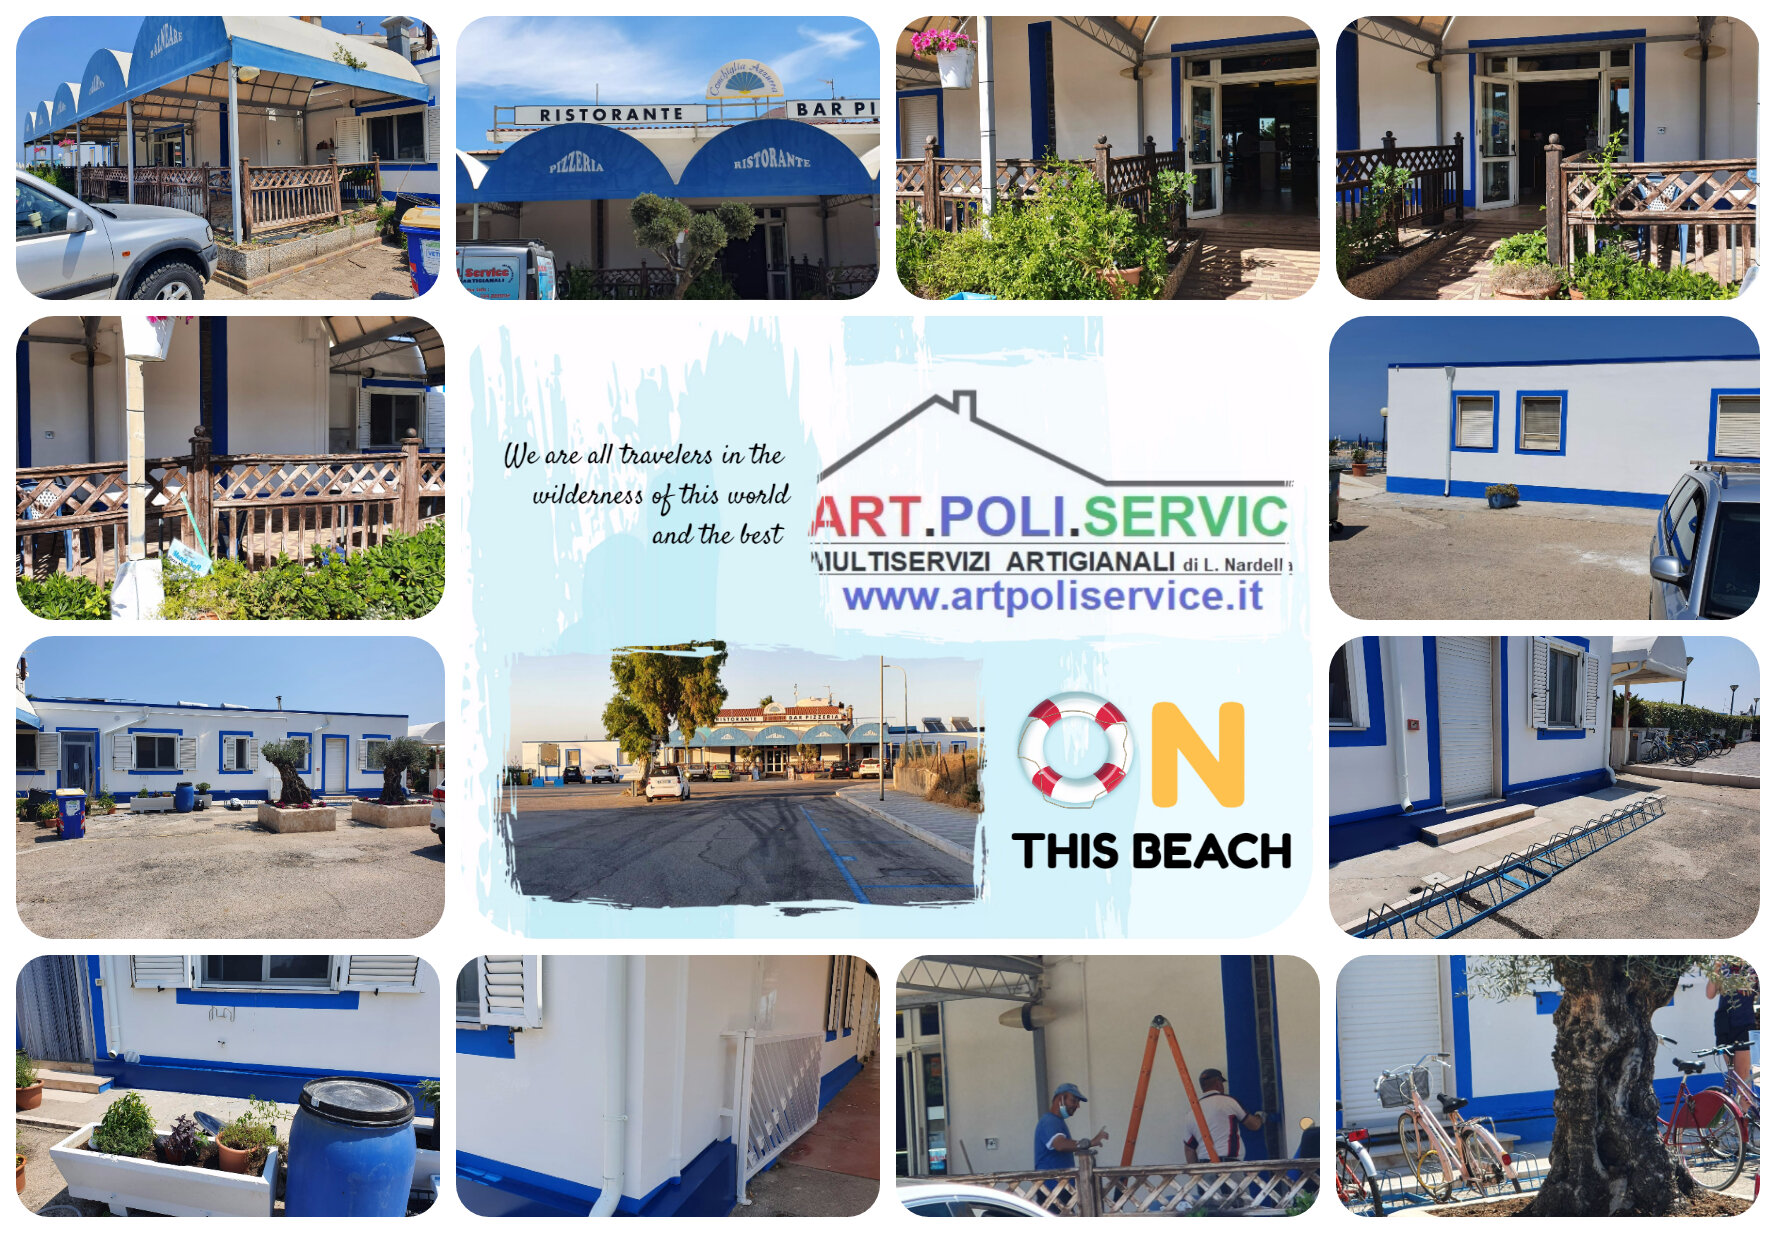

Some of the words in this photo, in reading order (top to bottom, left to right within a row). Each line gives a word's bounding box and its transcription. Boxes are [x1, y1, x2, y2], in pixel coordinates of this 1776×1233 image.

[710, 62, 746, 96] Conchiglia
[749, 63, 779, 93] Azzurra
[540, 108, 683, 122] RISTORANTE
[796, 102, 842, 116] BAR
[854, 102, 876, 116] PI
[549, 150, 604, 174] PIZZERIA
[734, 147, 811, 169] RISTORANTE
[465, 267, 509, 277] Service
